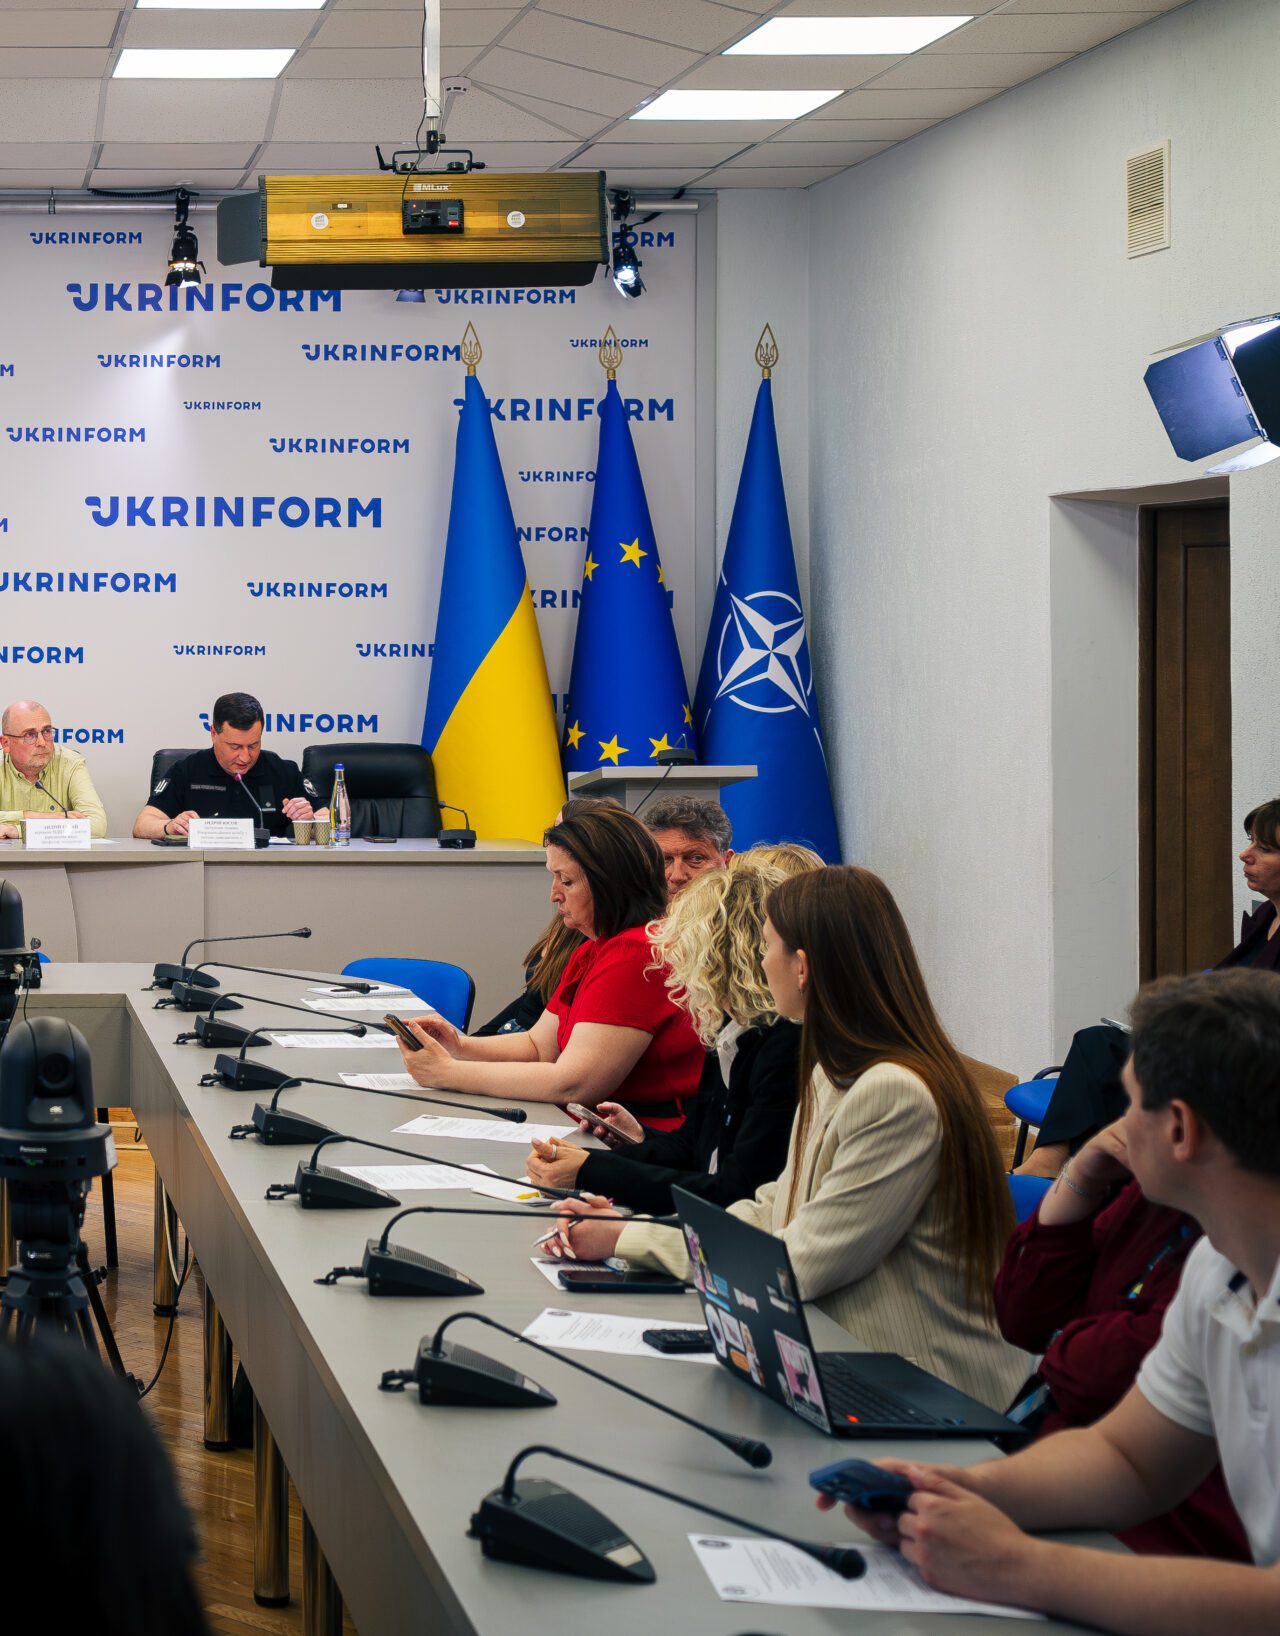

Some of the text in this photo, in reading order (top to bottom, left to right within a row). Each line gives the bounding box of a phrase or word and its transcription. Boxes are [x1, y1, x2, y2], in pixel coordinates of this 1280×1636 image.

[30, 231, 143, 245] UKRINFORM
[67, 283, 342, 312] UKRINFORM
[434, 289, 576, 305] UKRINFORM
[570, 338, 649, 348] UKRINFORM
[303, 344, 461, 361] UKRINFORM
[97, 354, 221, 367] UKRINFORM
[182, 401, 262, 410] UKRINFORM
[453, 398, 674, 421] KRINFRM
[7, 427, 146, 443] UKRINFORM
[270, 438, 410, 453] UKRINFORM
[519, 471, 595, 482] UKRINFO
[85, 495, 382, 528] UKRINFORM
[248, 582, 388, 598] UKRINFORM
[173, 645, 266, 656] UKRINFORM
